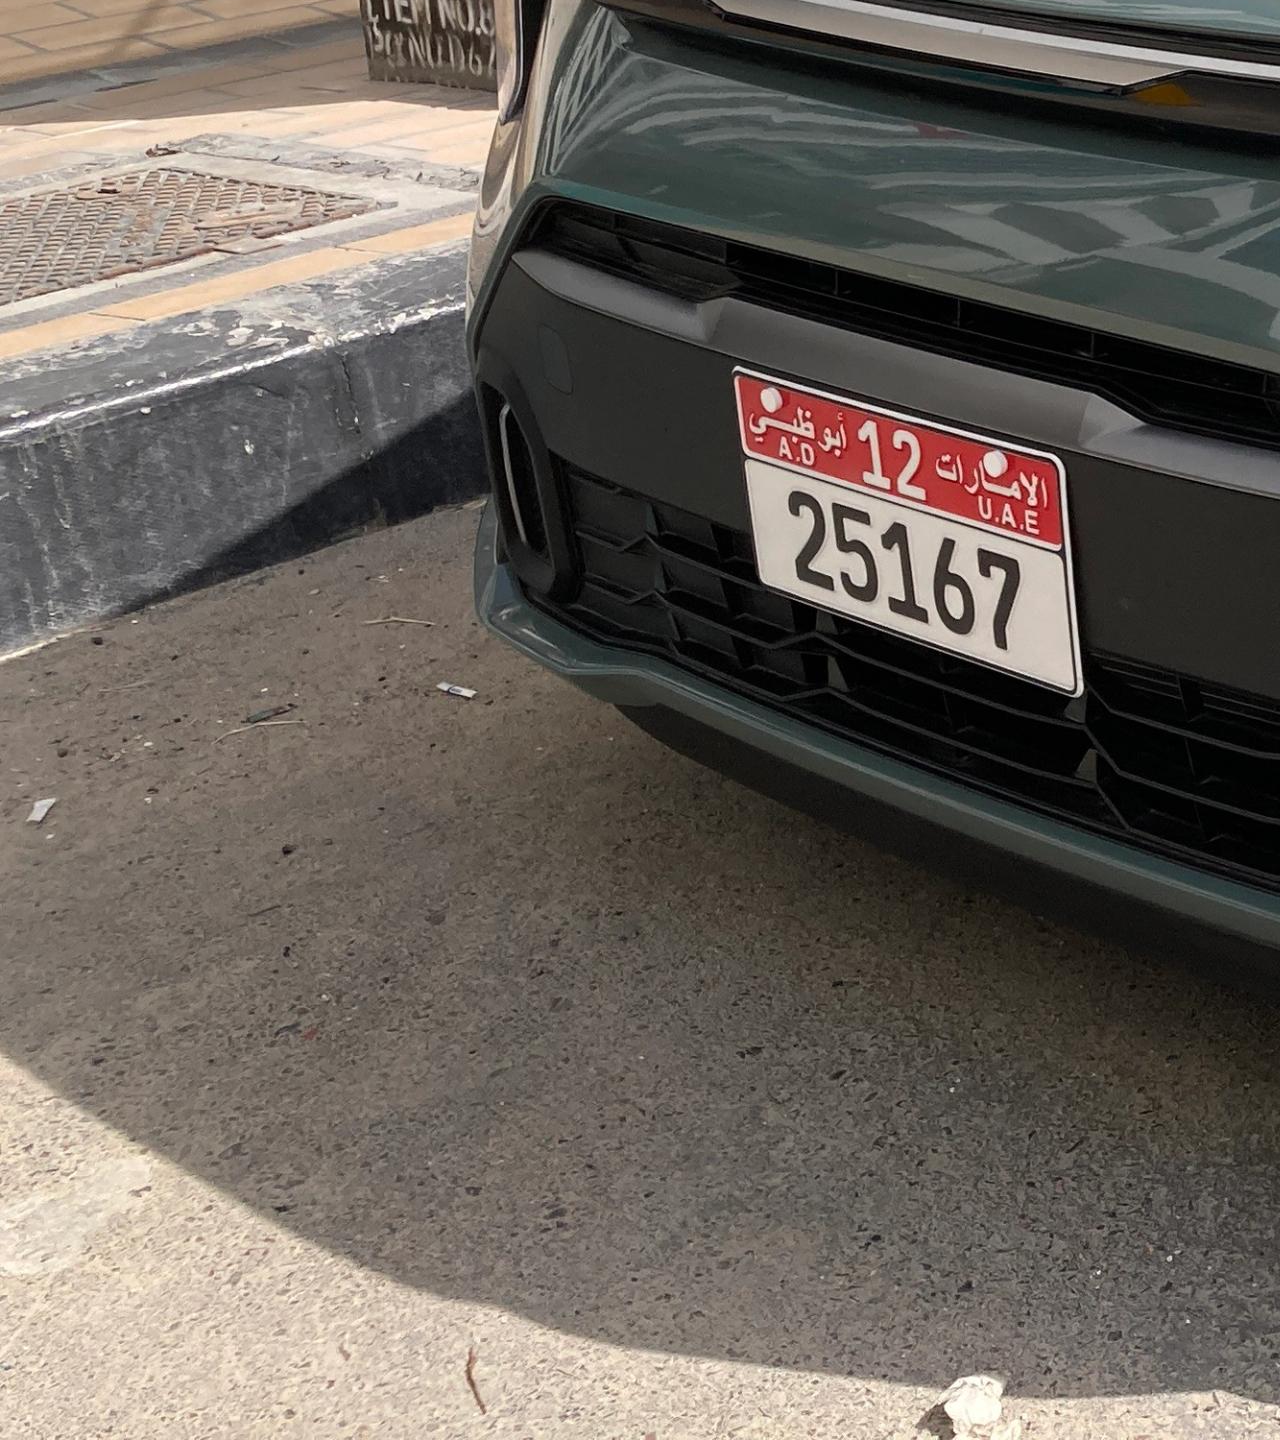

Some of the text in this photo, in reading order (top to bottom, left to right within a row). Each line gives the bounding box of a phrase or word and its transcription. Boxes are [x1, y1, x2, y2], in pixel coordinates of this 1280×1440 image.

[779, 436, 816, 467] A.D
[858, 420, 927, 501] 12
[978, 495, 1041, 536] U.A.E
[788, 490, 1021, 651] 25167
